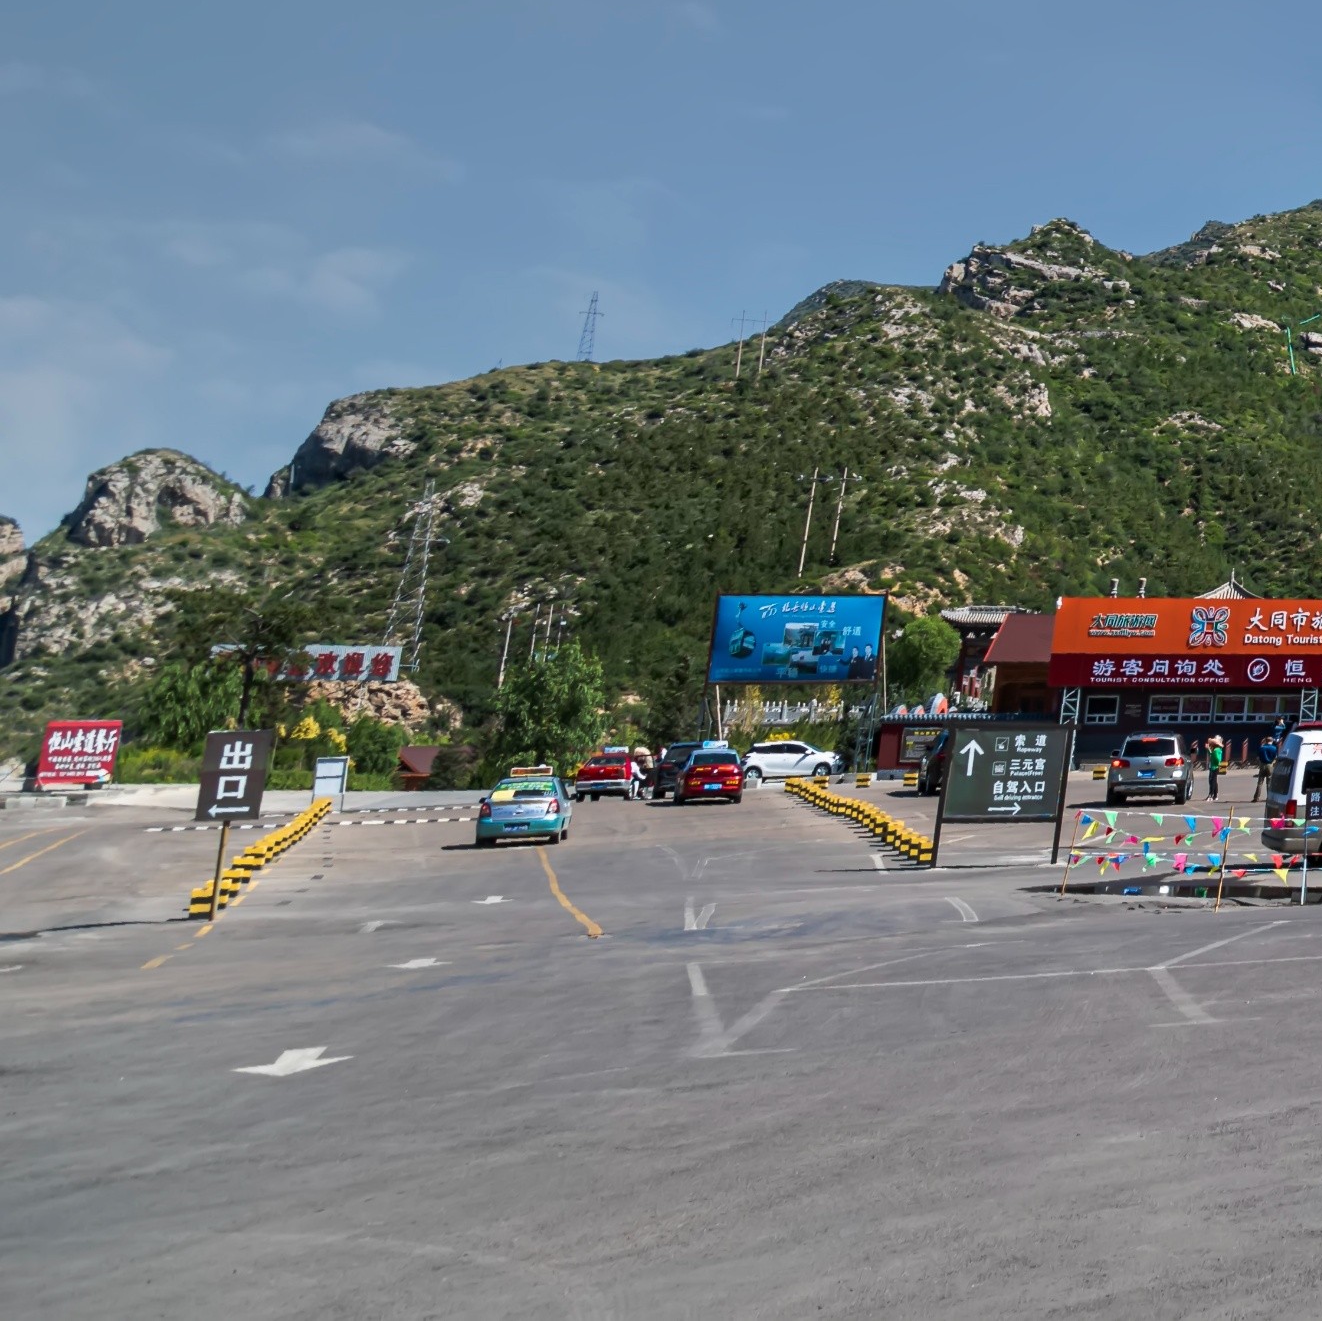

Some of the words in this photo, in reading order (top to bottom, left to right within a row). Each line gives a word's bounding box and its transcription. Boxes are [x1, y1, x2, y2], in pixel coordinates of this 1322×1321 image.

[1089, 613, 1158, 628] 大同旅游网
[1244, 634, 1283, 646] Datong
[1286, 634, 1322, 644] Tourist
[1092, 658, 1226, 676] 游客问询处
[1015, 734, 1047, 747] 索道
[216, 740, 253, 800] 出口
[1009, 758, 1047, 770] 三元宫
[993, 780, 1046, 795] 自驾入口
